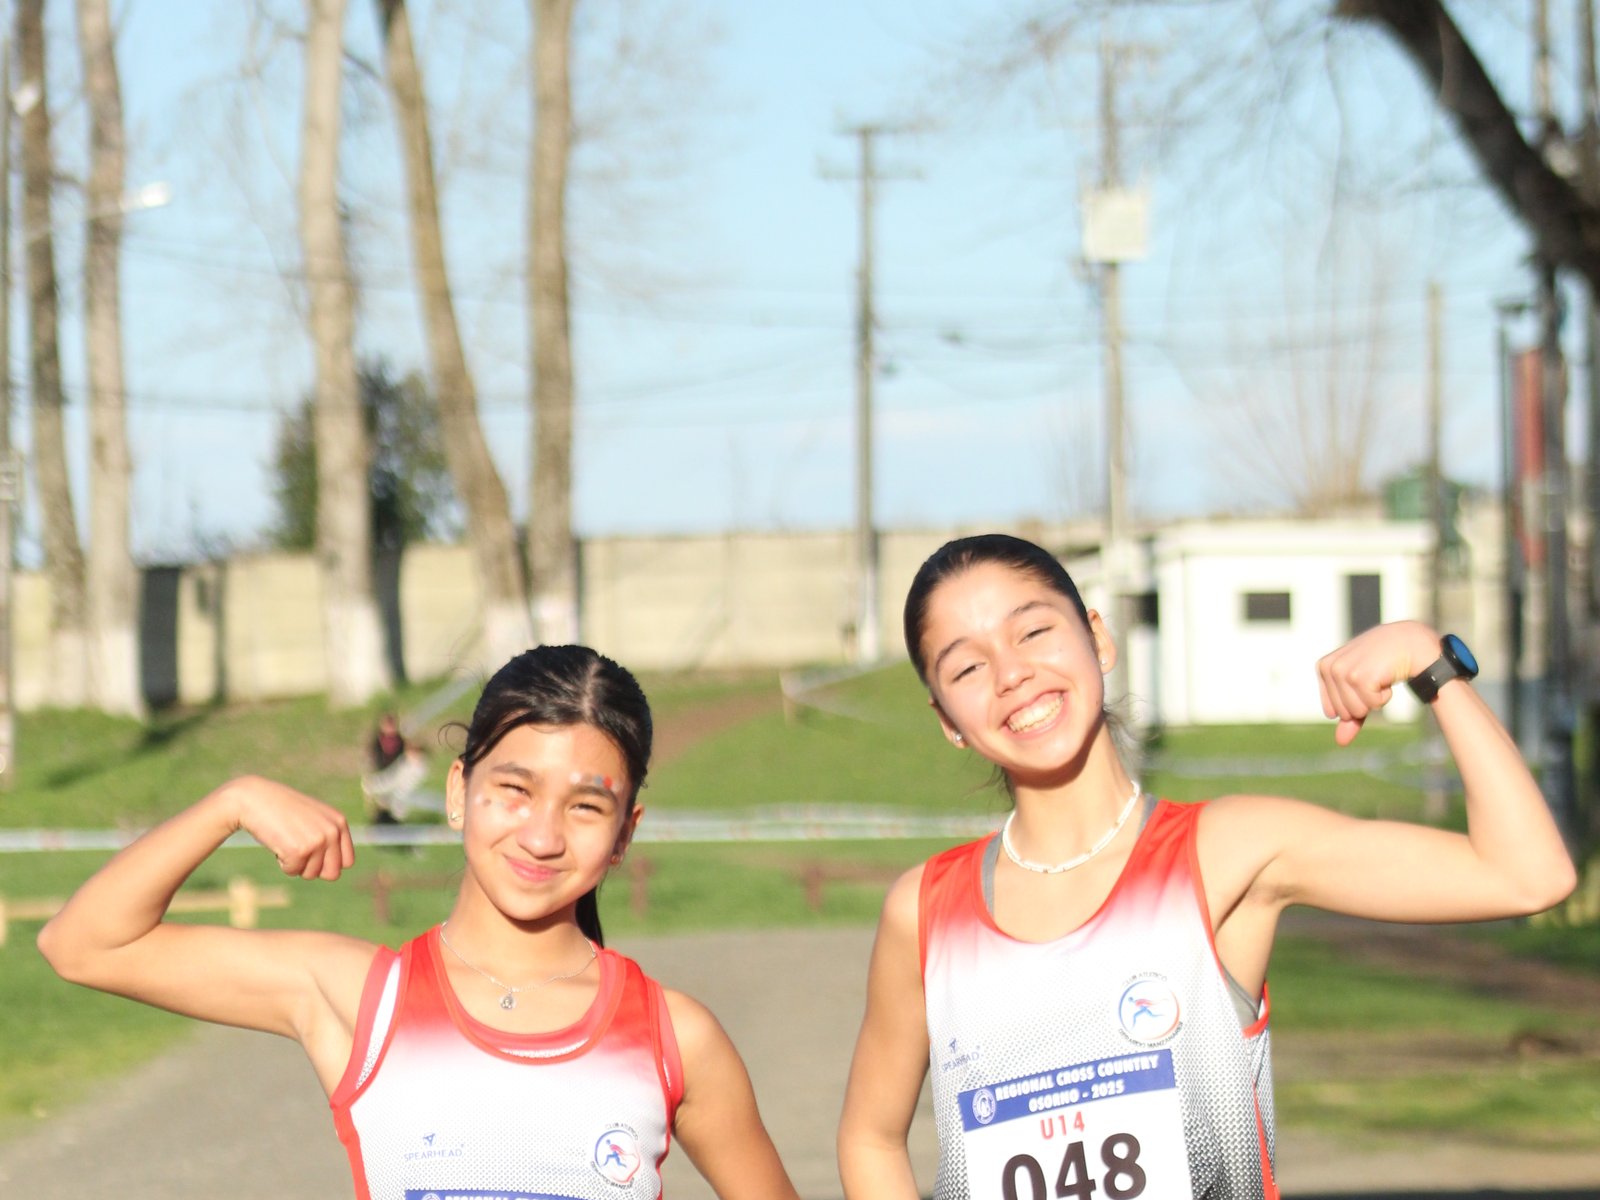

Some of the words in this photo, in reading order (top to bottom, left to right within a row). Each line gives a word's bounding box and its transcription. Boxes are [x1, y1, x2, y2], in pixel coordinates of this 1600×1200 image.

[995, 1075, 1054, 1101] REGIONAL
[1056, 1065, 1095, 1086] CROSS
[1097, 1054, 1159, 1077] COUNTRY
[1028, 1088, 1079, 1112] OSORNO
[1081, 1091, 1089, 1099] -
[1091, 1079, 1125, 1099] 2025
[1040, 1111, 1085, 1140] U14
[403, 1148, 463, 1161] SPEARHEAD
